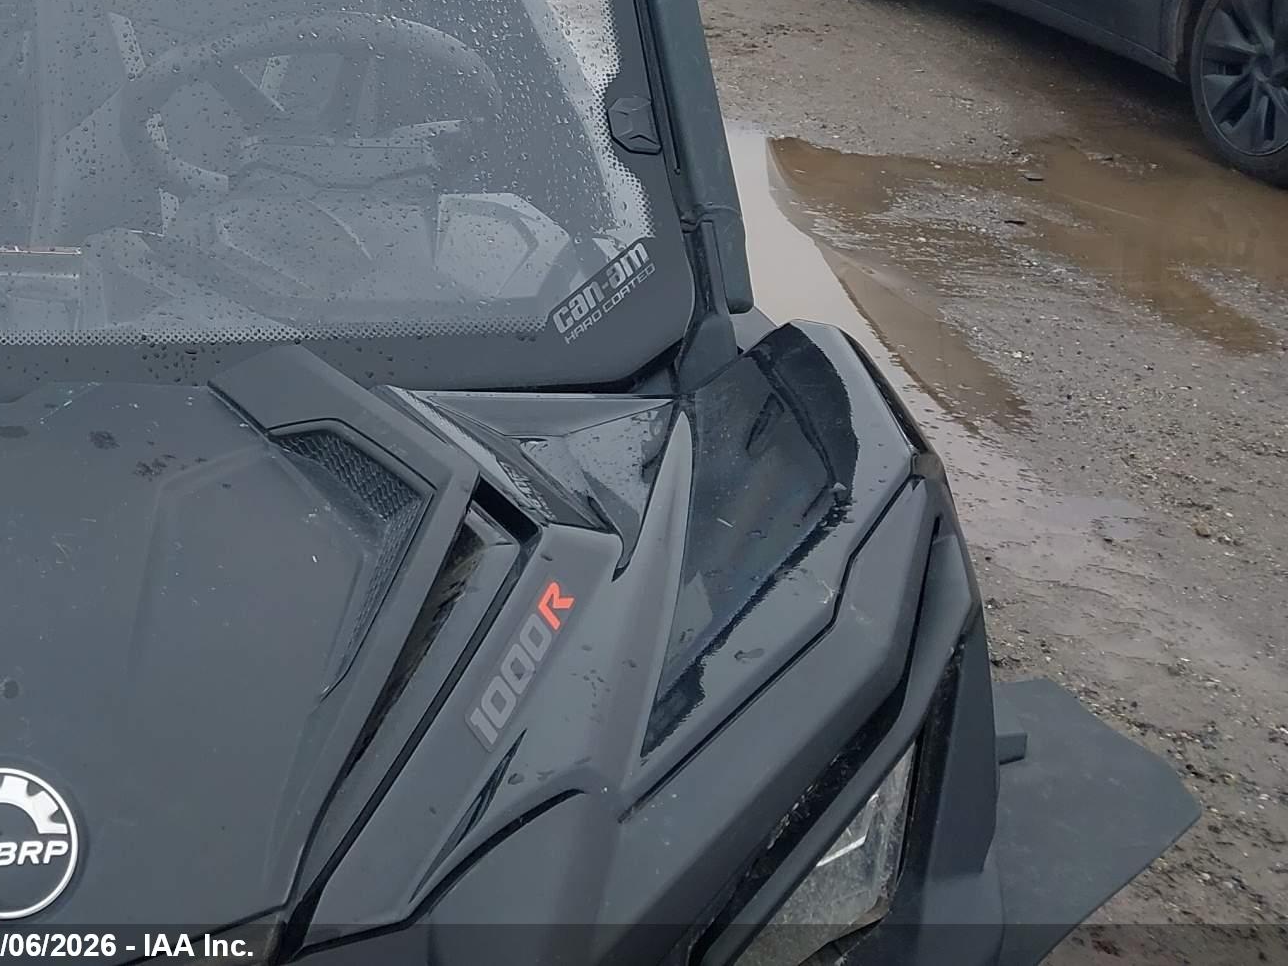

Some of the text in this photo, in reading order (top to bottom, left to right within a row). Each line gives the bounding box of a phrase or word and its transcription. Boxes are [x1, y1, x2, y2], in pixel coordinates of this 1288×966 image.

[553, 242, 650, 334] can-am
[564, 263, 656, 344] HARD COATED
[470, 581, 575, 745] 1000R
